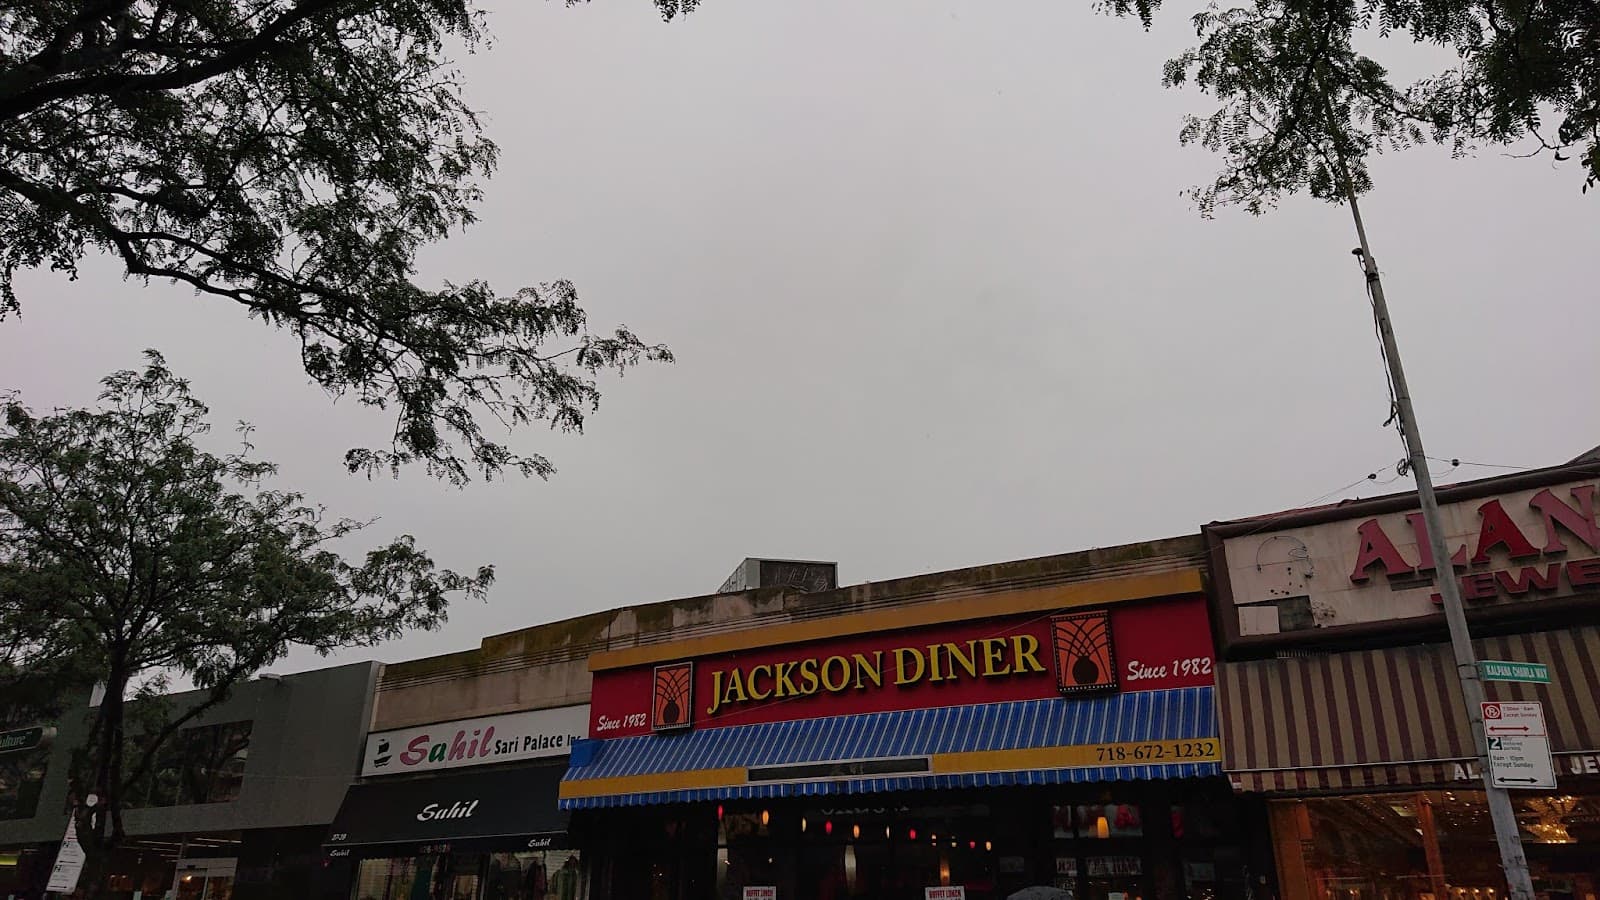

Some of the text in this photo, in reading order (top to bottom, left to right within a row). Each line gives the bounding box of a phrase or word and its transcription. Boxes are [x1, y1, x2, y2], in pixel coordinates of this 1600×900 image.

[707, 634, 1046, 714] JACKSON DINER
[1126, 656, 1212, 680] Since 1982
[596, 712, 647, 732] Since 1982
[400, 726, 495, 766] Sahil
[495, 737, 519, 755] Sari
[523, 734, 563, 751] Palace
[1096, 742, 1215, 761] 718-672-1232
[1489, 736, 1502, 750] 2
[416, 799, 479, 821] Sahil
[527, 837, 551, 848] Sahil
